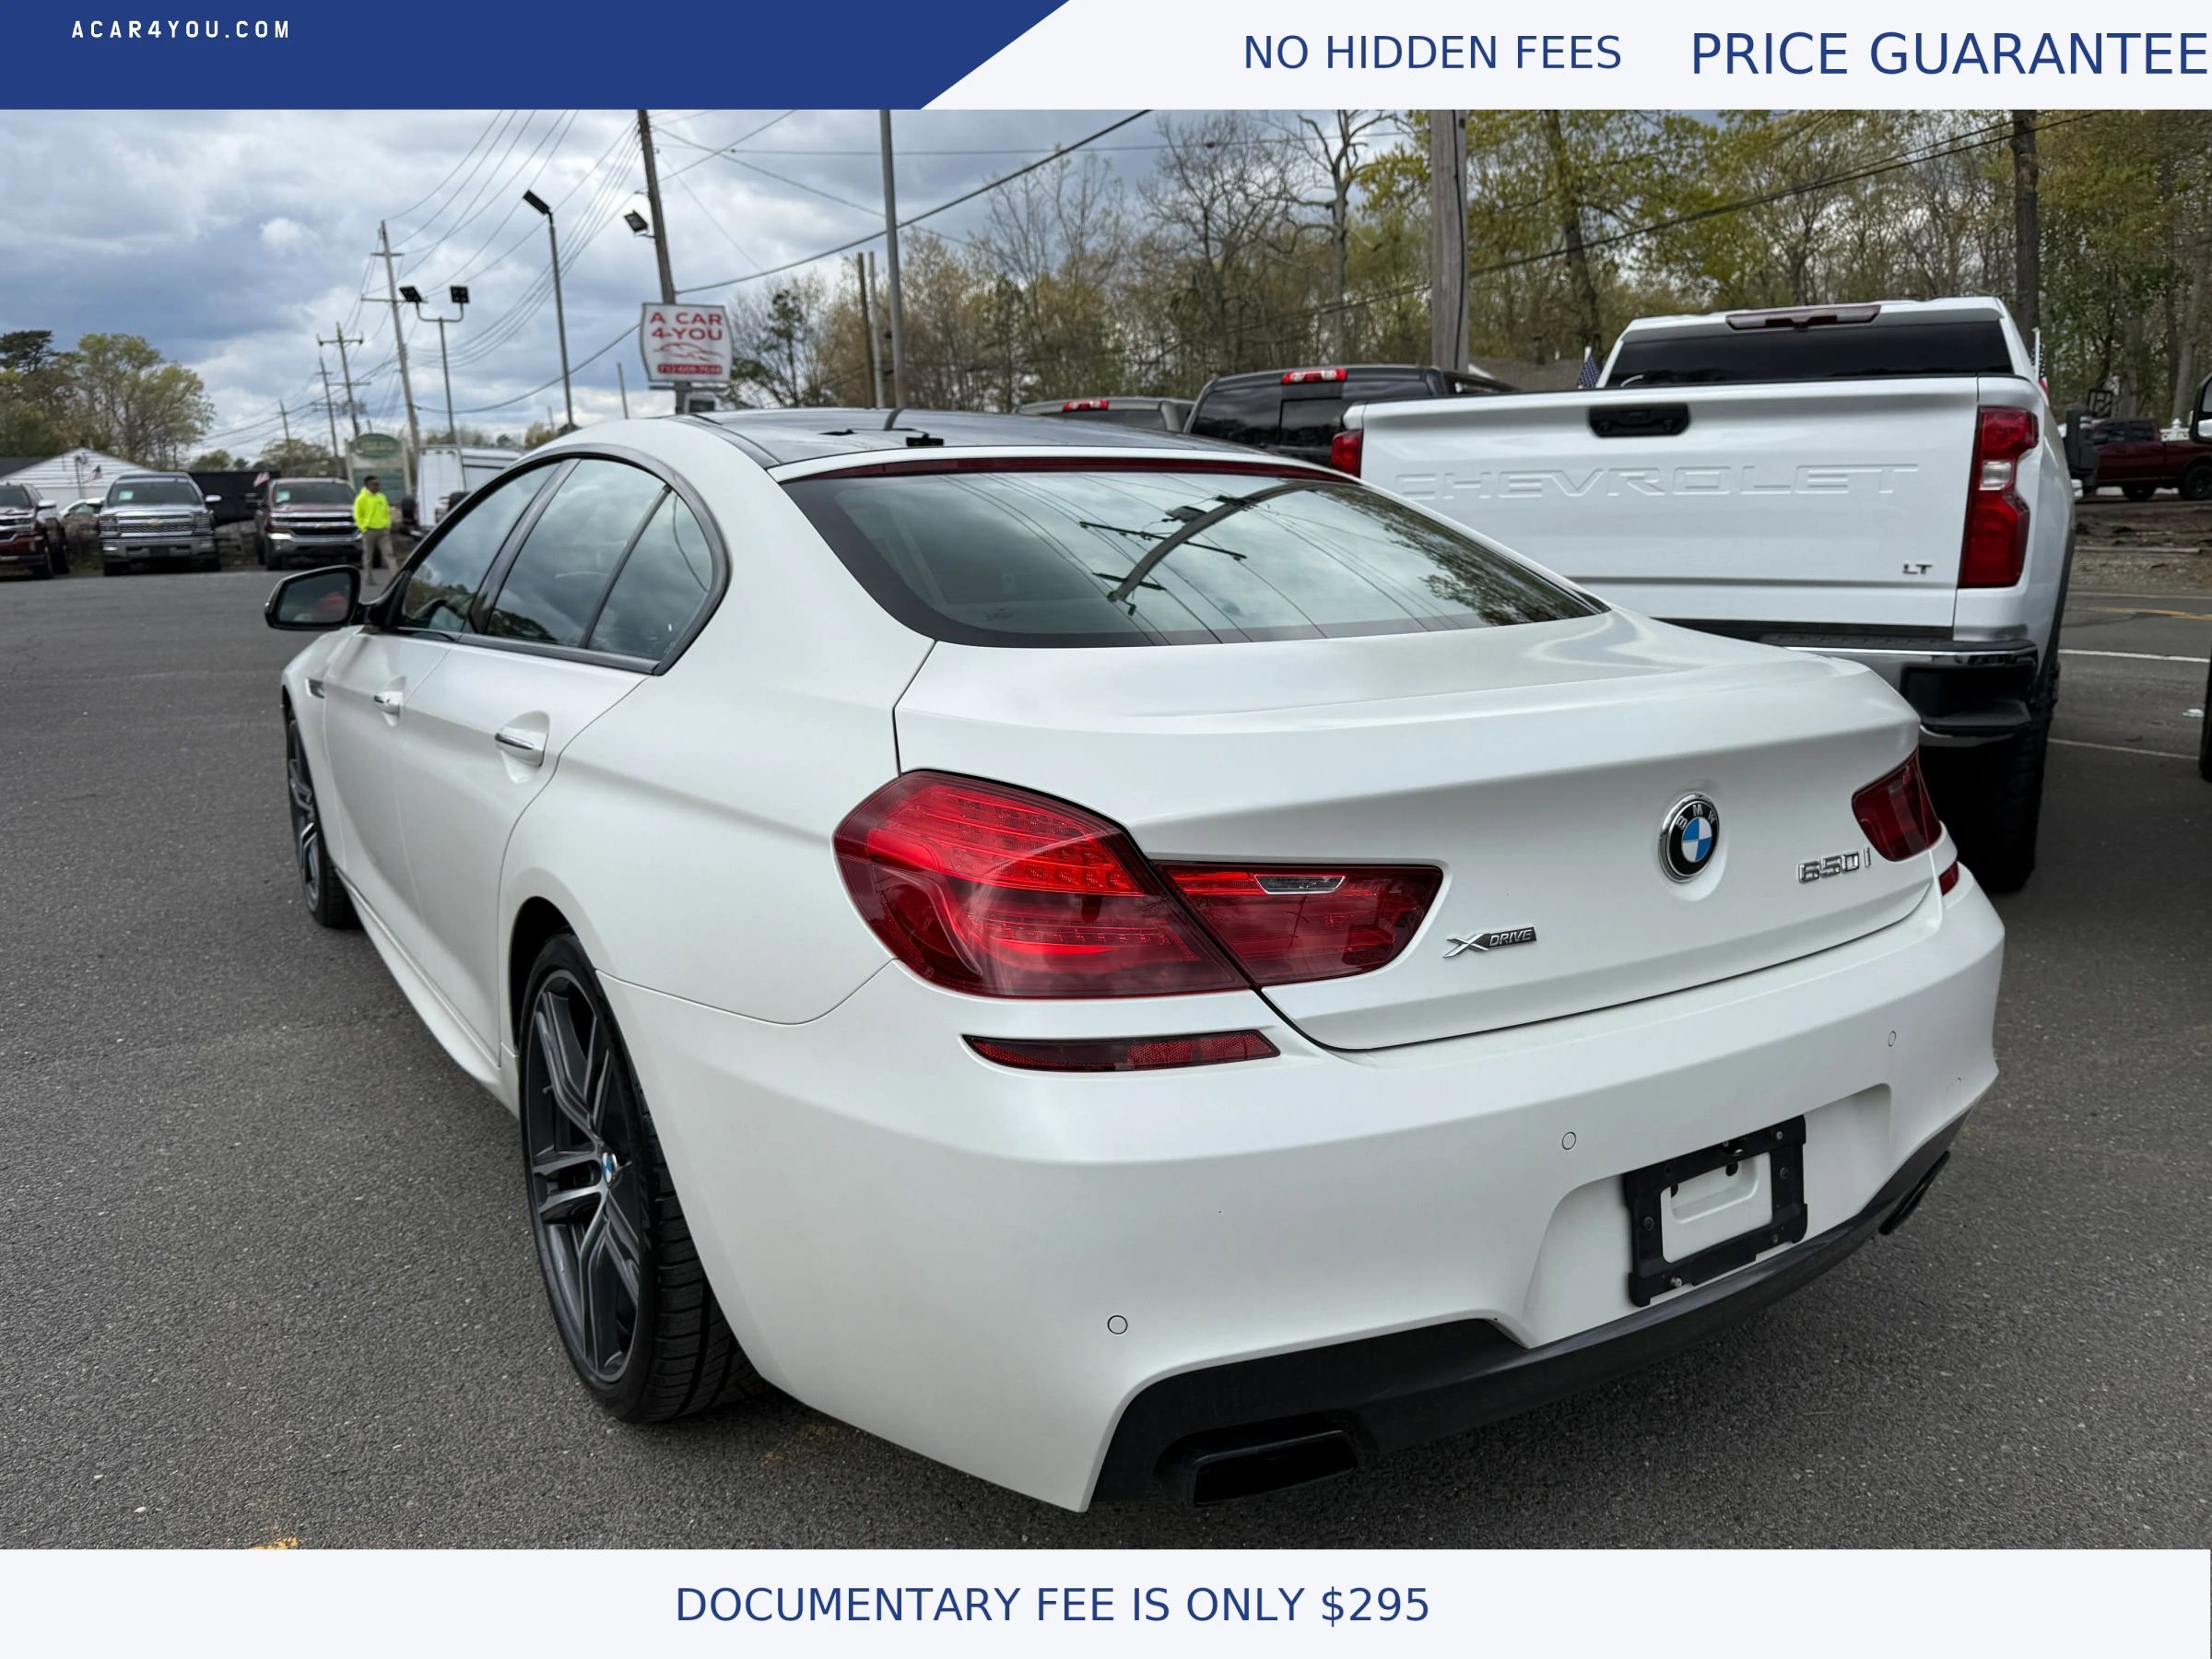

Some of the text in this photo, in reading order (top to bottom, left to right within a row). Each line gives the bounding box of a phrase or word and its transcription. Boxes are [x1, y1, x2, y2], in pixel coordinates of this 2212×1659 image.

[650, 312, 723, 325] A CAR
[1396, 464, 1919, 500] CHEVROLET
[1902, 563, 1933, 575] LT
[1676, 804, 1716, 830] BMW
